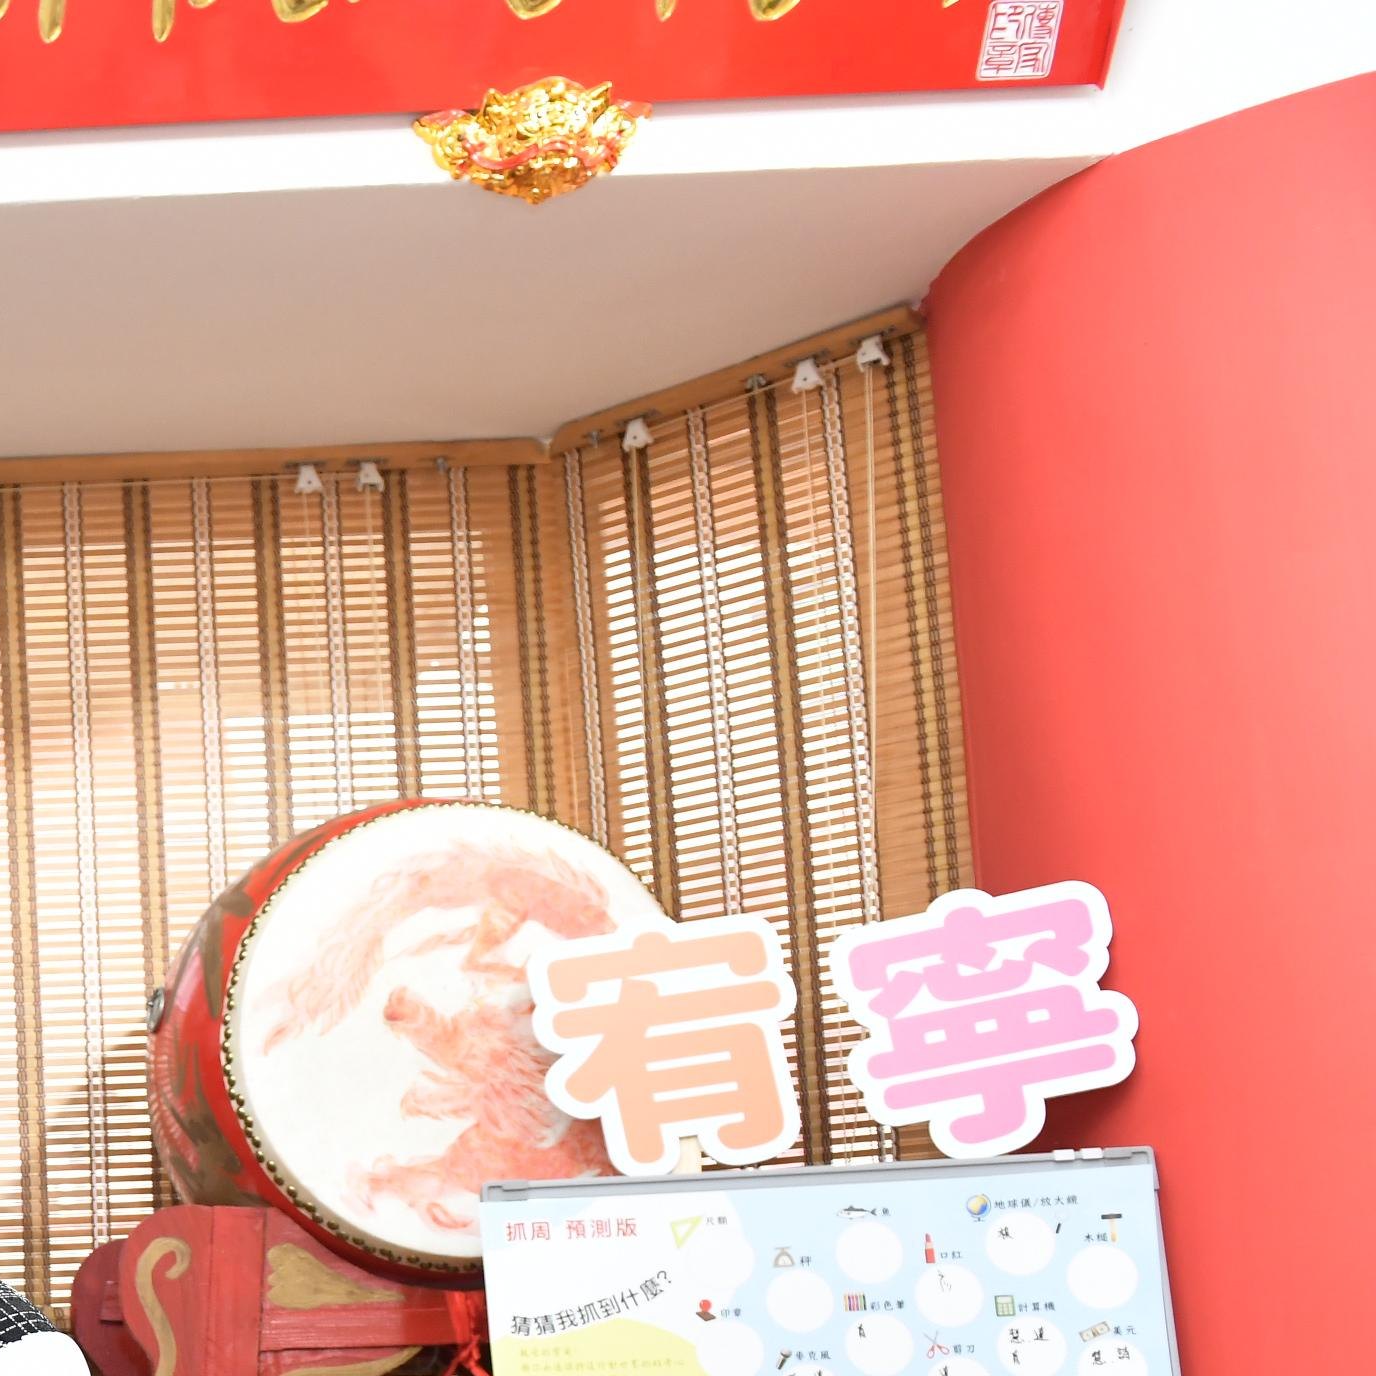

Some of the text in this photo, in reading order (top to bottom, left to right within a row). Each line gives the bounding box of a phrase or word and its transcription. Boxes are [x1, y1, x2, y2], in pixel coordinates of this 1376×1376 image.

[506, 1217, 639, 1242] 抓周 預測版
[511, 1270, 673, 1337] 猜猜我抓到什麼?
